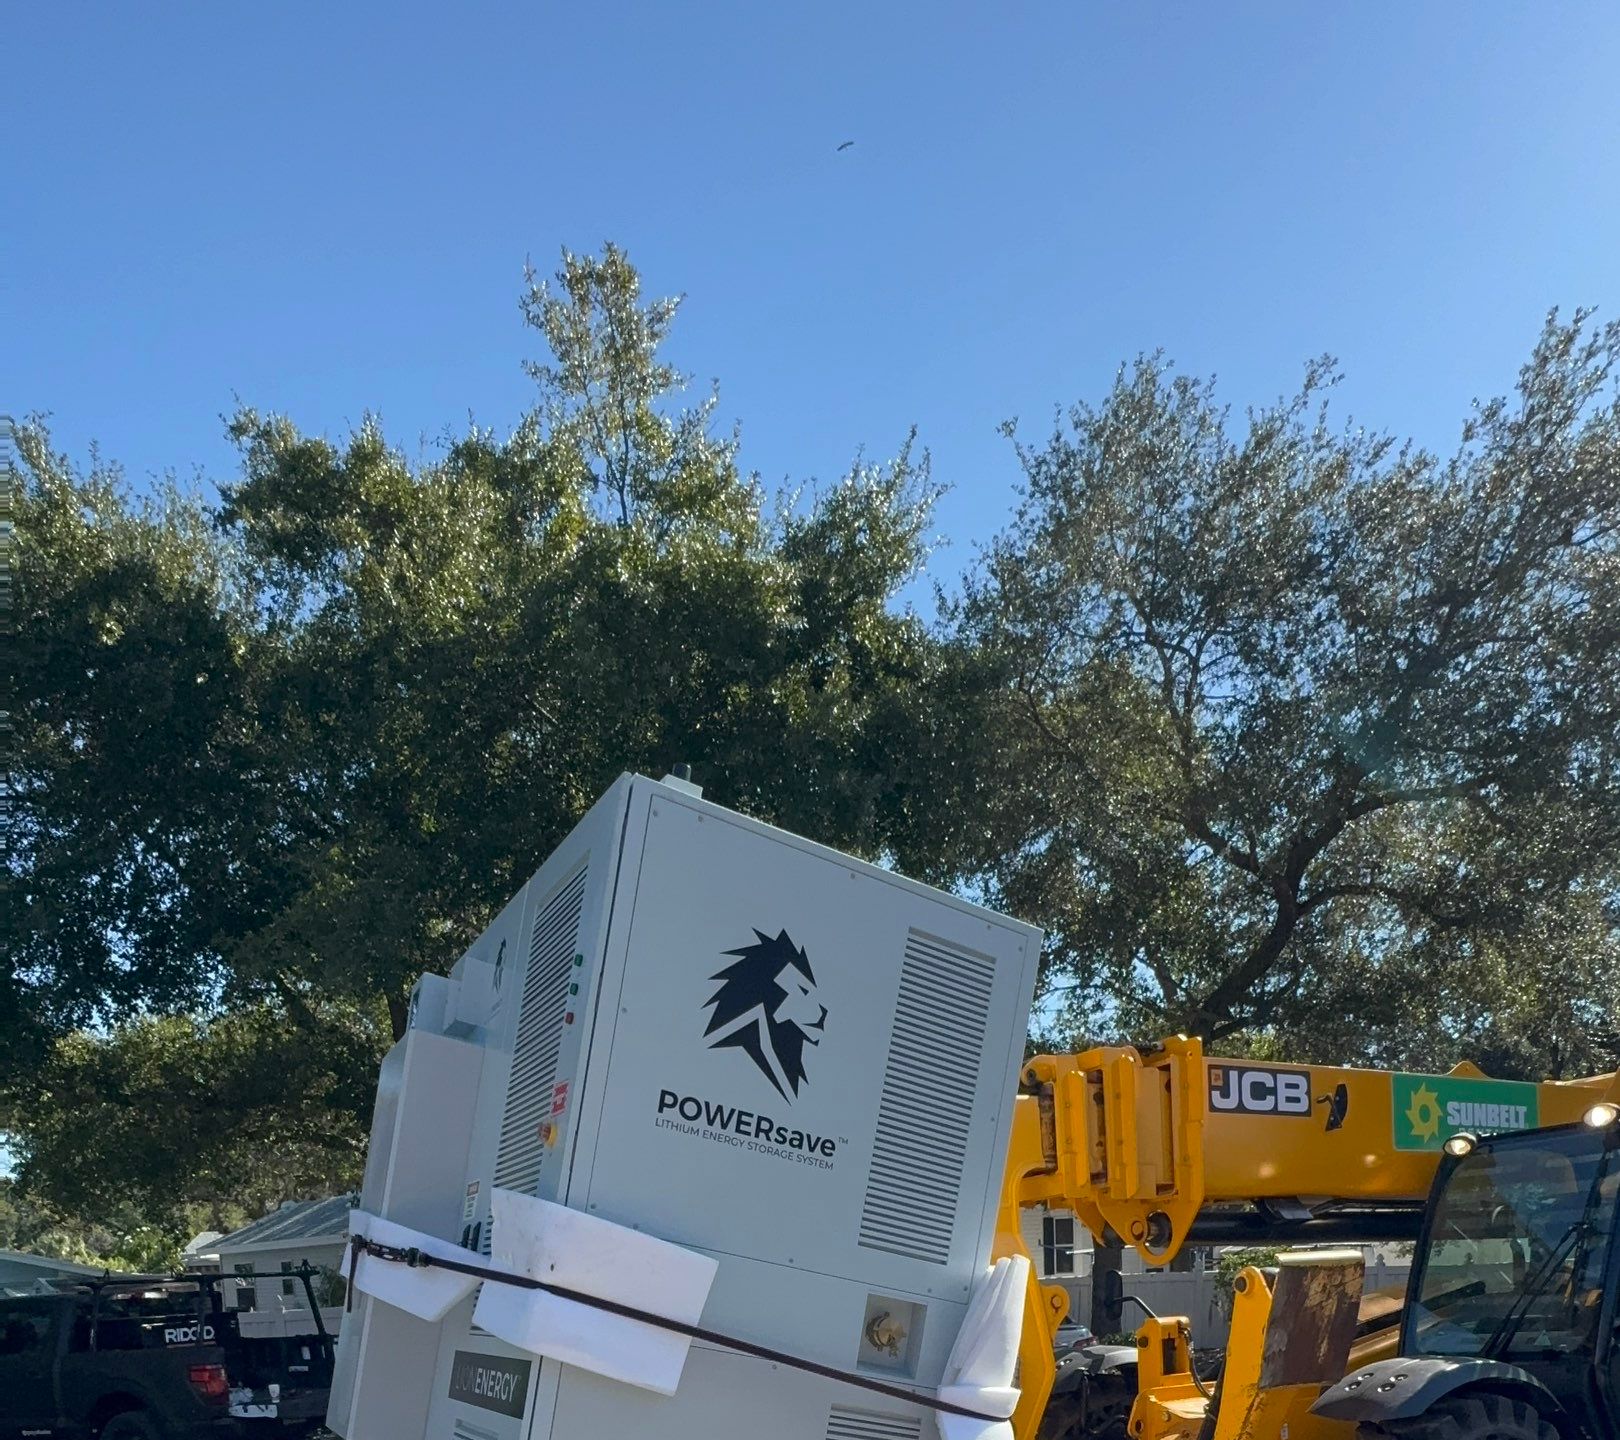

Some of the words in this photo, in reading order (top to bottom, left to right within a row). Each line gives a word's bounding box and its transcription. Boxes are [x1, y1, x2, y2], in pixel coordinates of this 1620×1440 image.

[1211, 1069, 1309, 1113] JCB
[1446, 1101, 1528, 1129] SUNBELT
[655, 1117, 700, 1137] LITHIUM
[702, 1129, 746, 1148] ENERGY
[747, 1141, 794, 1162] STORAGE
[796, 1153, 835, 1172] SYSTEM
[164, 1325, 215, 1344] RIDGD
